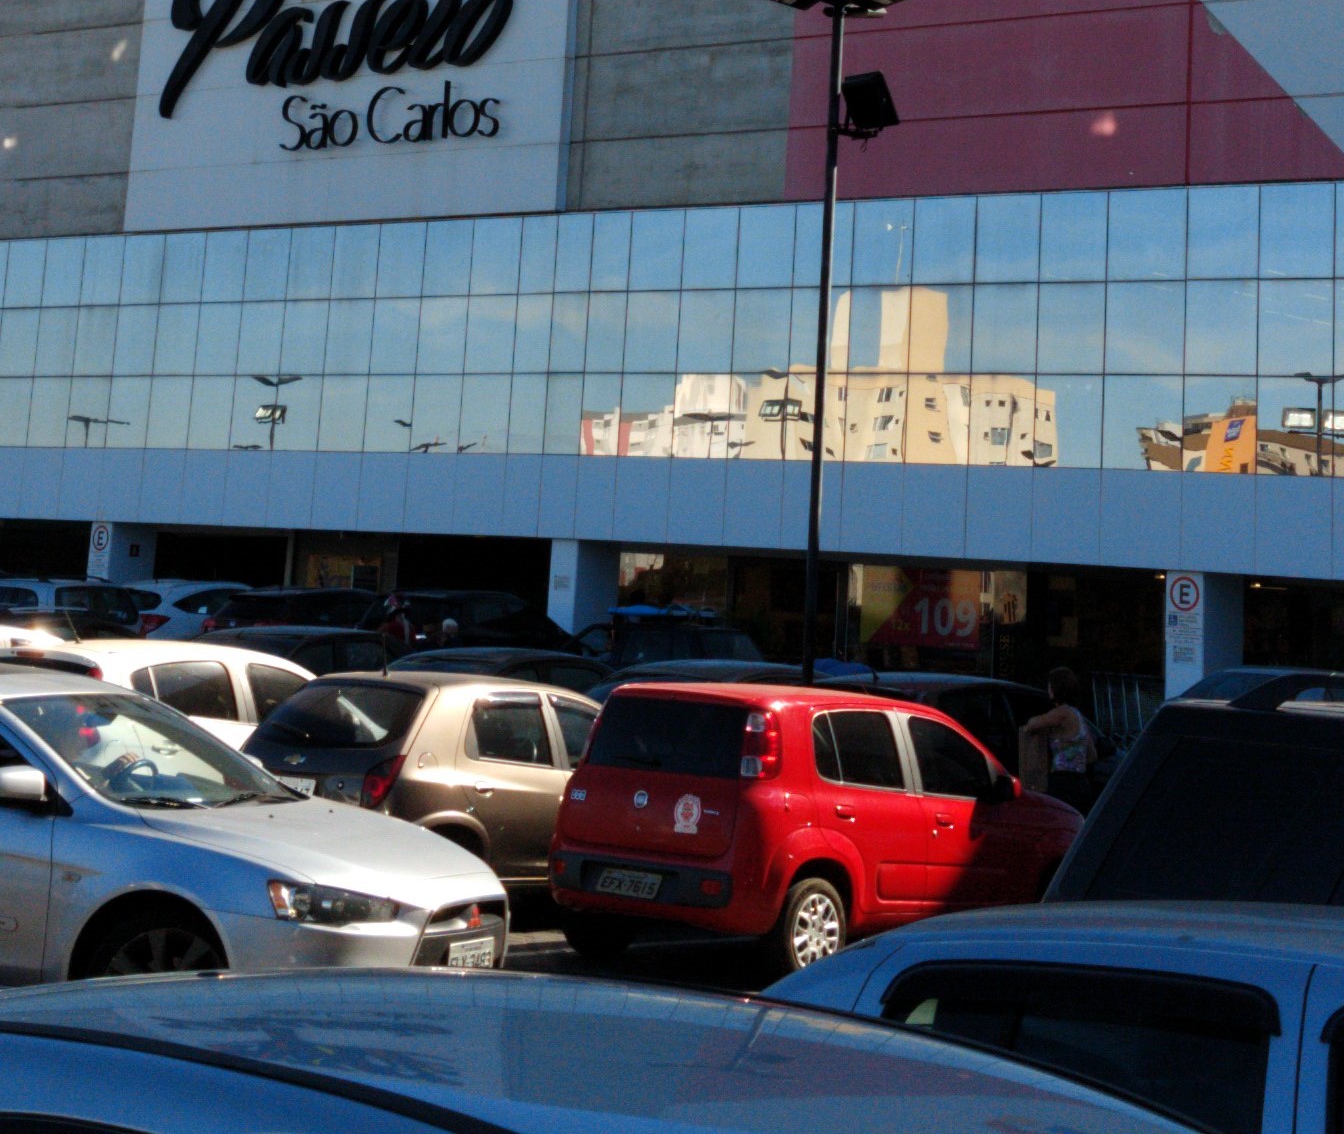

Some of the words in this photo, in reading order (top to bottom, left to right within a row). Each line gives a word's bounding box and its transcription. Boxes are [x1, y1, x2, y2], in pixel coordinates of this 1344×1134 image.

[279, 95, 358, 151] São
[366, 80, 500, 144] Carlos
[1179, 583, 1191, 604] E
[914, 597, 978, 637] 109
